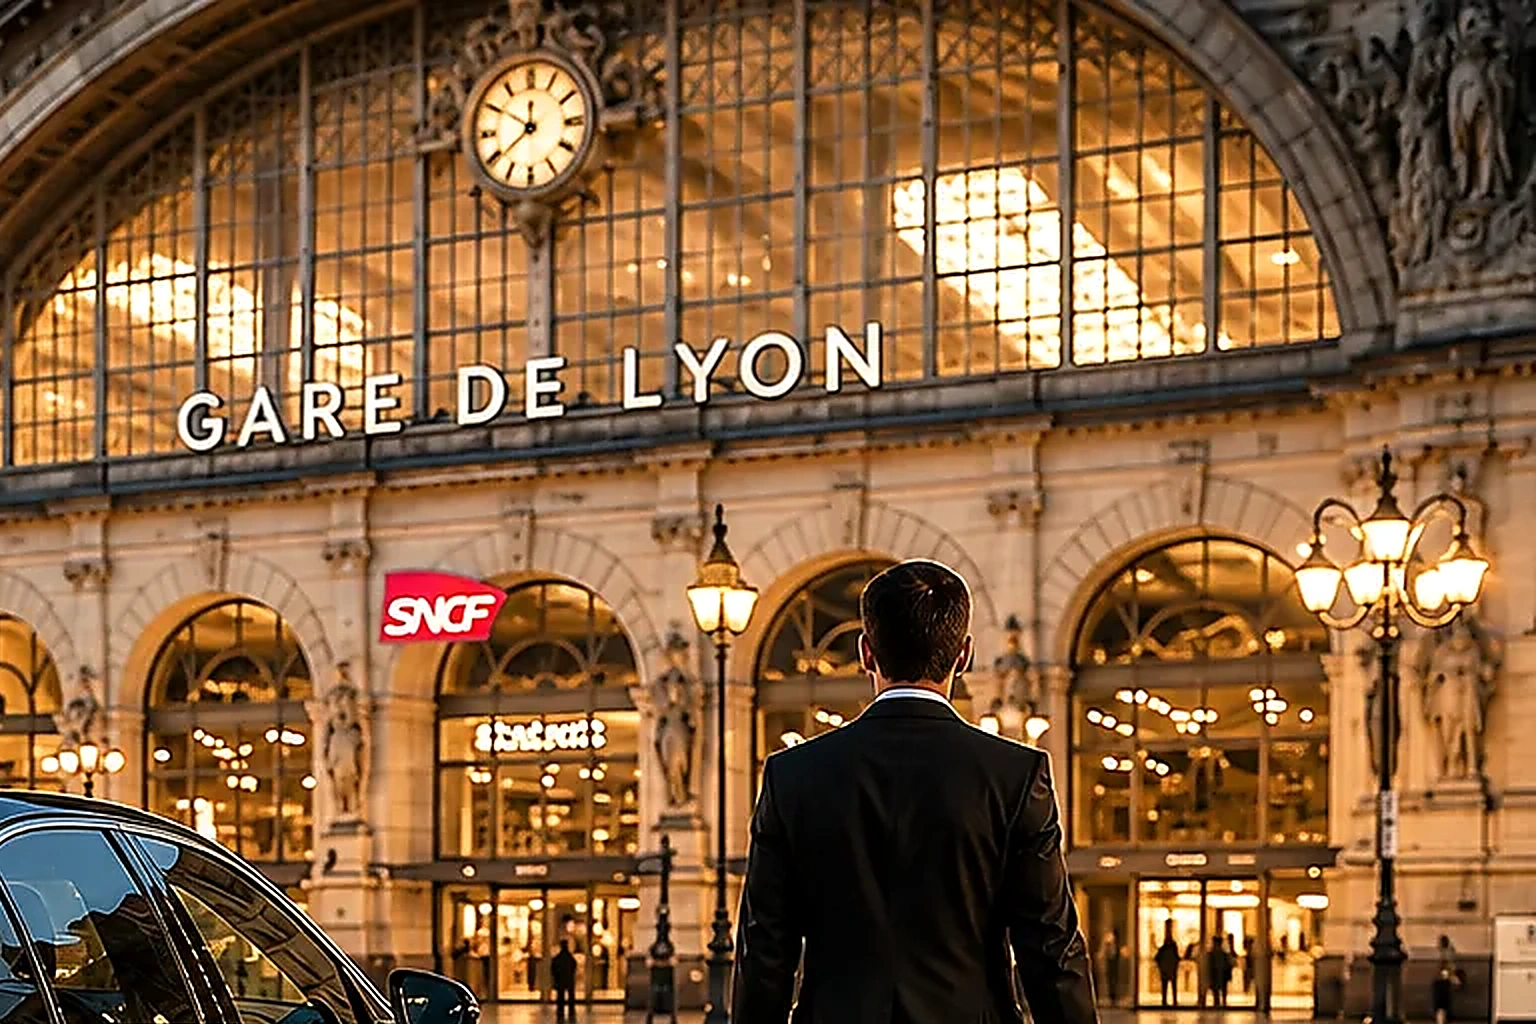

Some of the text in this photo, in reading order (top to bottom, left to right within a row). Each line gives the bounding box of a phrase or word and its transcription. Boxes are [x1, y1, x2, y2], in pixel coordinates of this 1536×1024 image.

[177, 320, 883, 452] GARE DE LYON
[383, 594, 497, 637] SNCF
